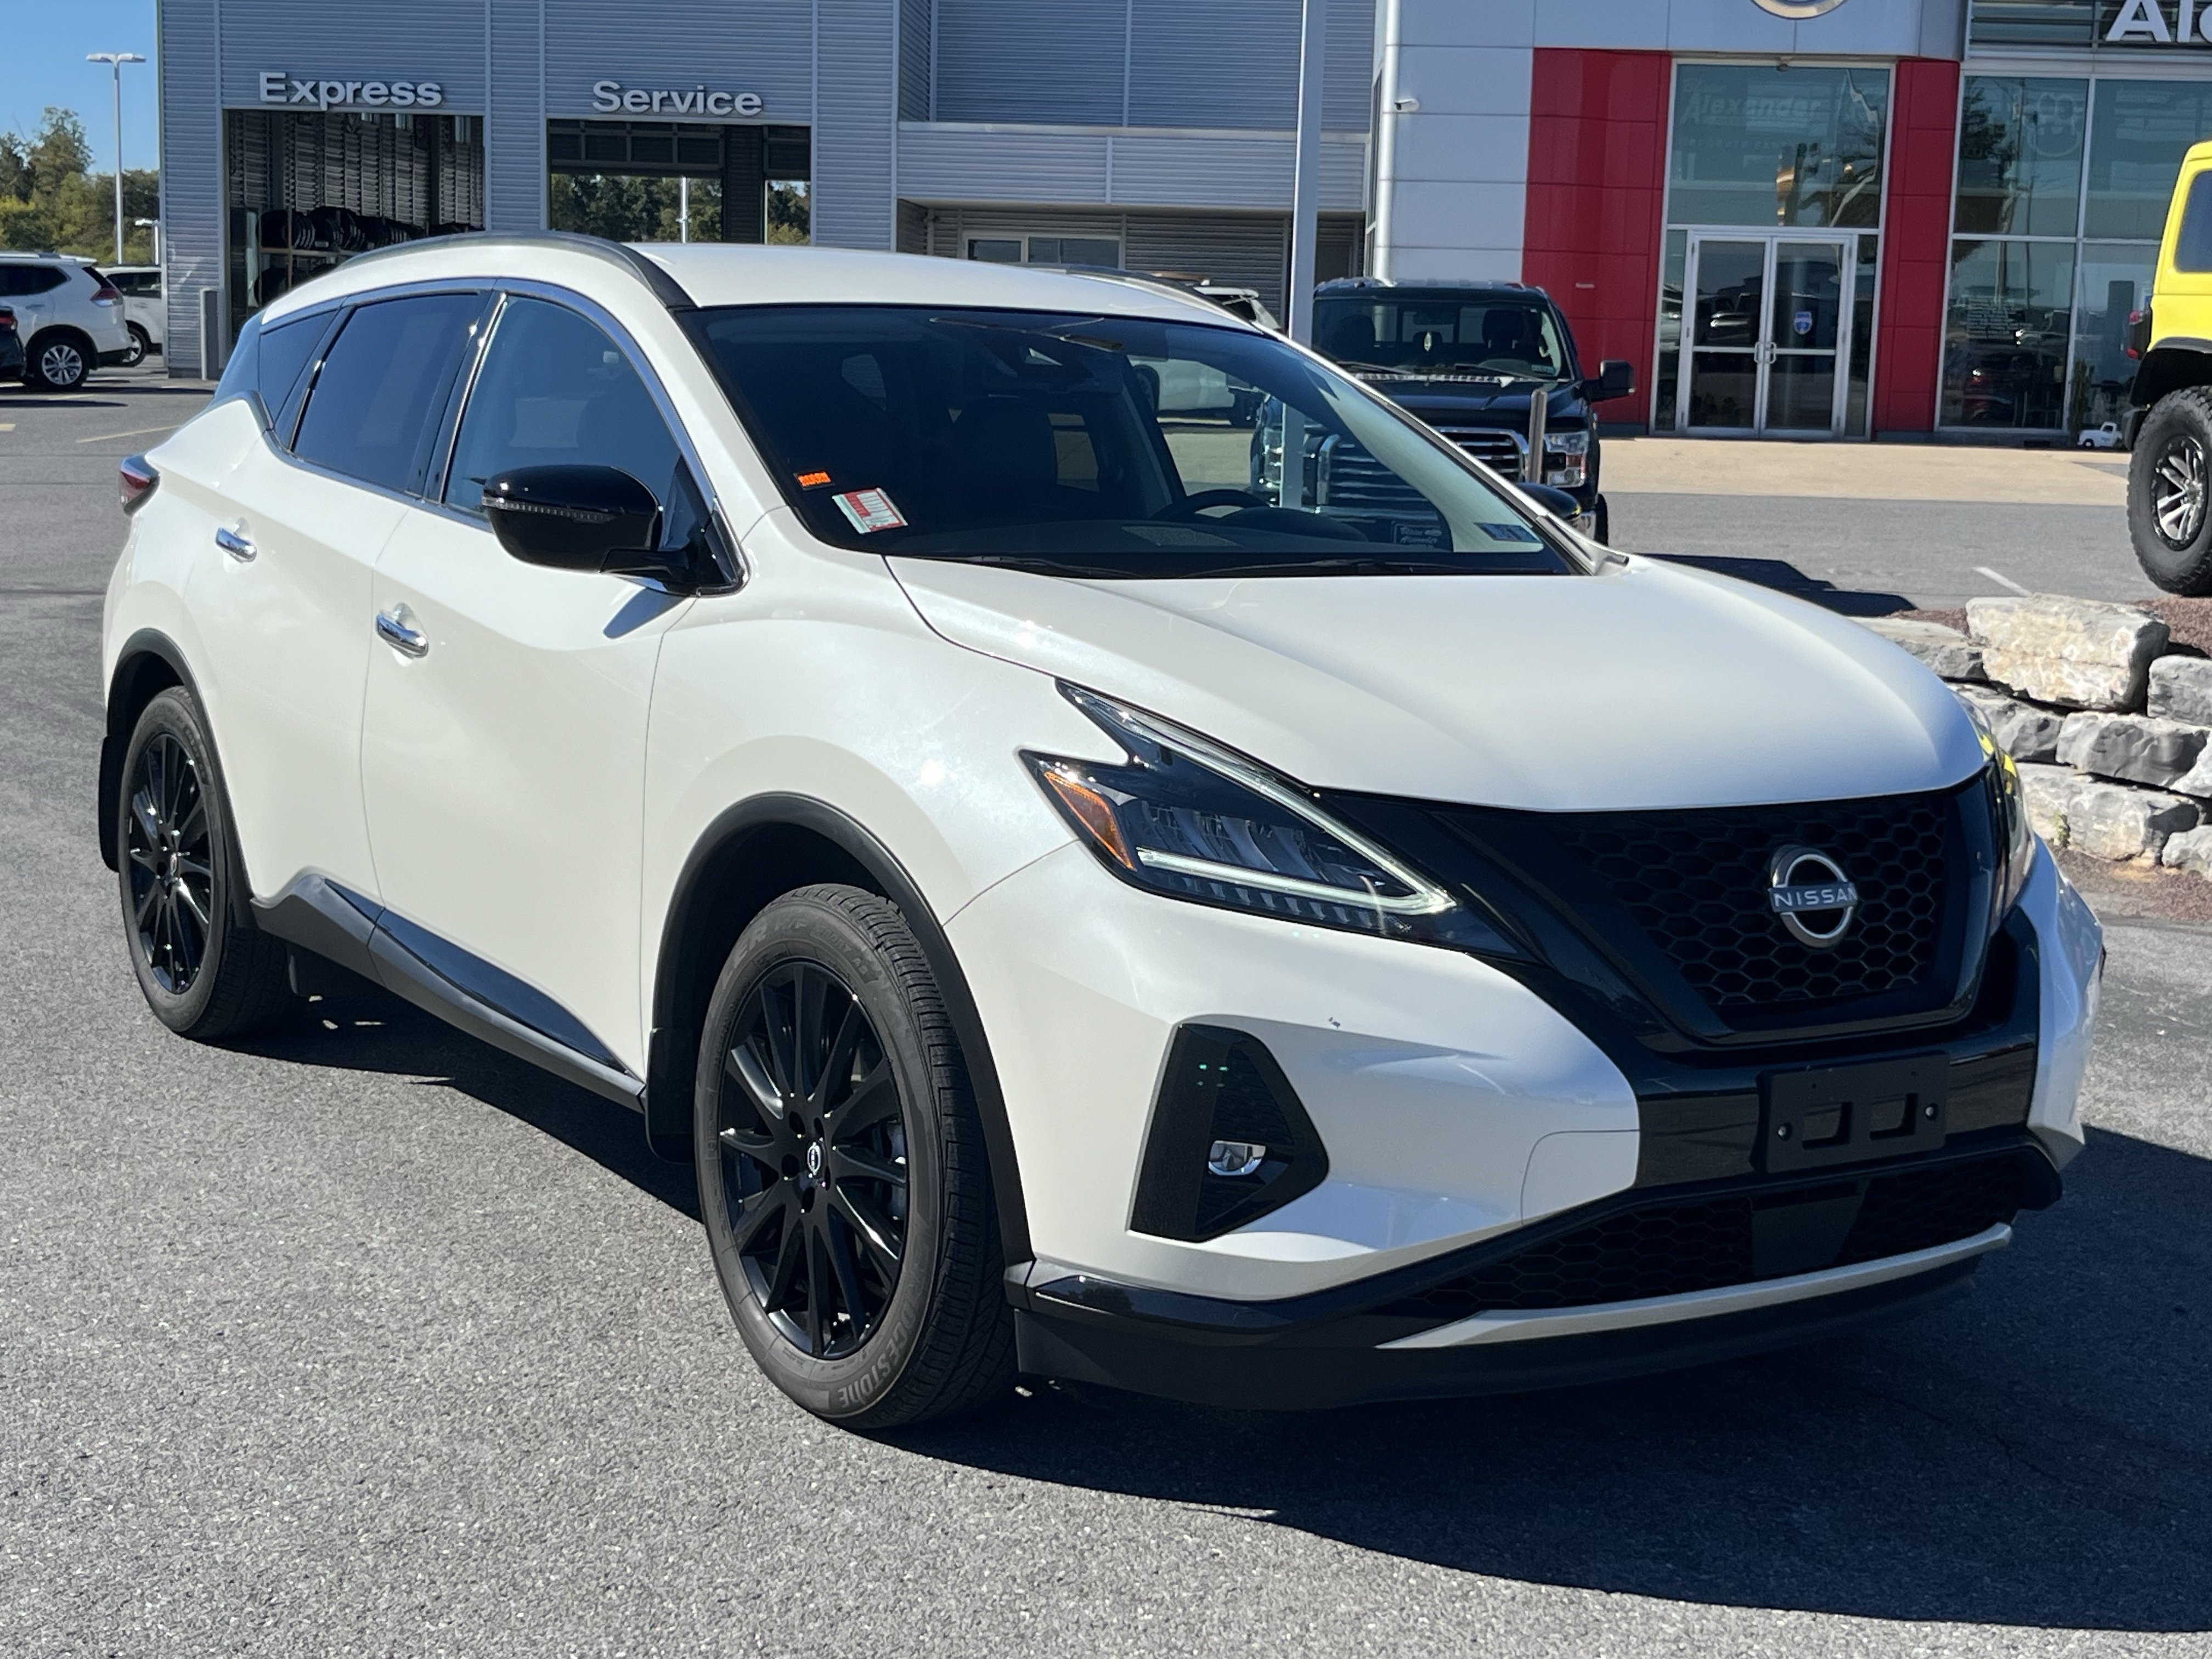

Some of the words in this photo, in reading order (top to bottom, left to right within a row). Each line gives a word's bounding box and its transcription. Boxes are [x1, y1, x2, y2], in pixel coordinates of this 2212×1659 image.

[2106, 0, 2212, 43] Al
[259, 72, 442, 110] Express
[593, 81, 762, 116] Service
[1774, 888, 1858, 907] NISSAN
